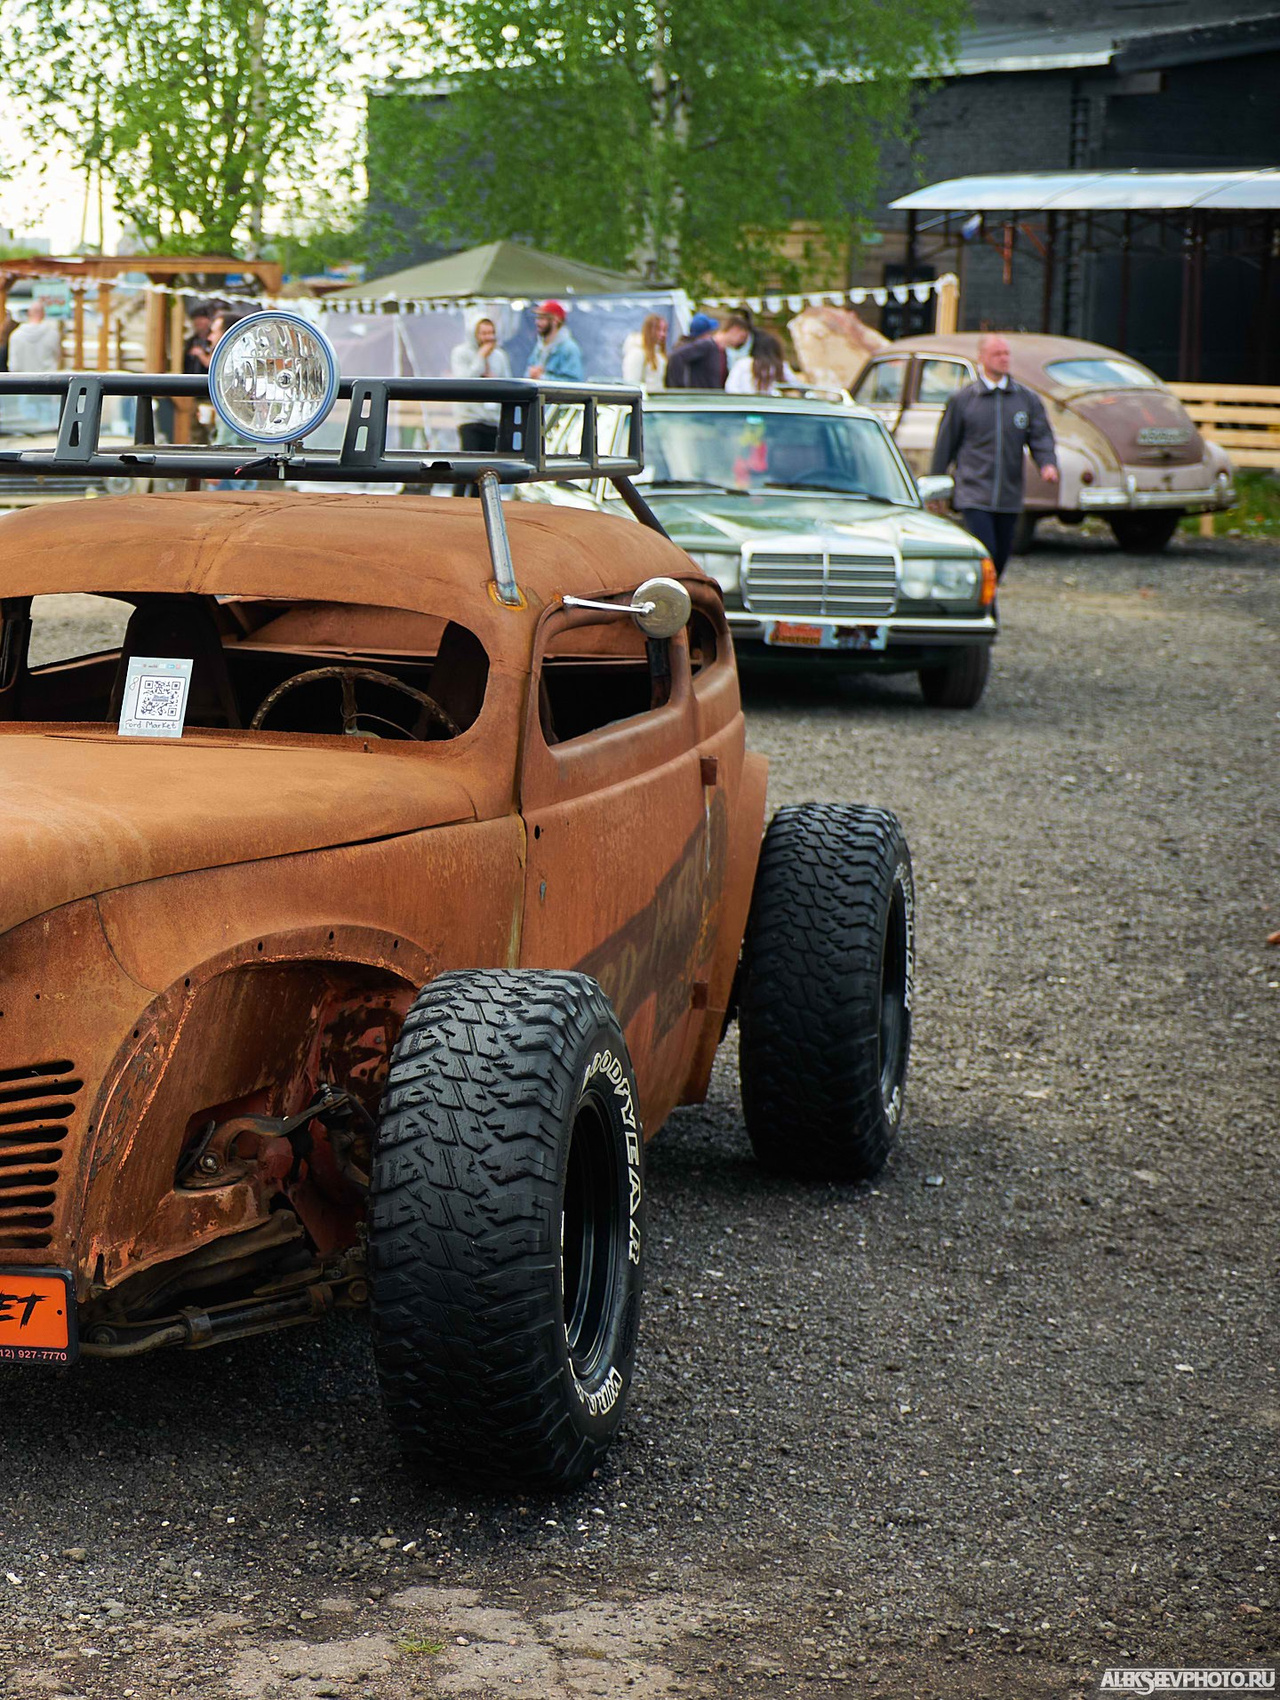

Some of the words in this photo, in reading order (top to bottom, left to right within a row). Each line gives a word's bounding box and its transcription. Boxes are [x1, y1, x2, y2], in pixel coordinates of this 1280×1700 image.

[125, 719, 142, 729] Ford
[146, 721, 177, 730] Market
[18, 1350, 67, 1361] 927-7770
